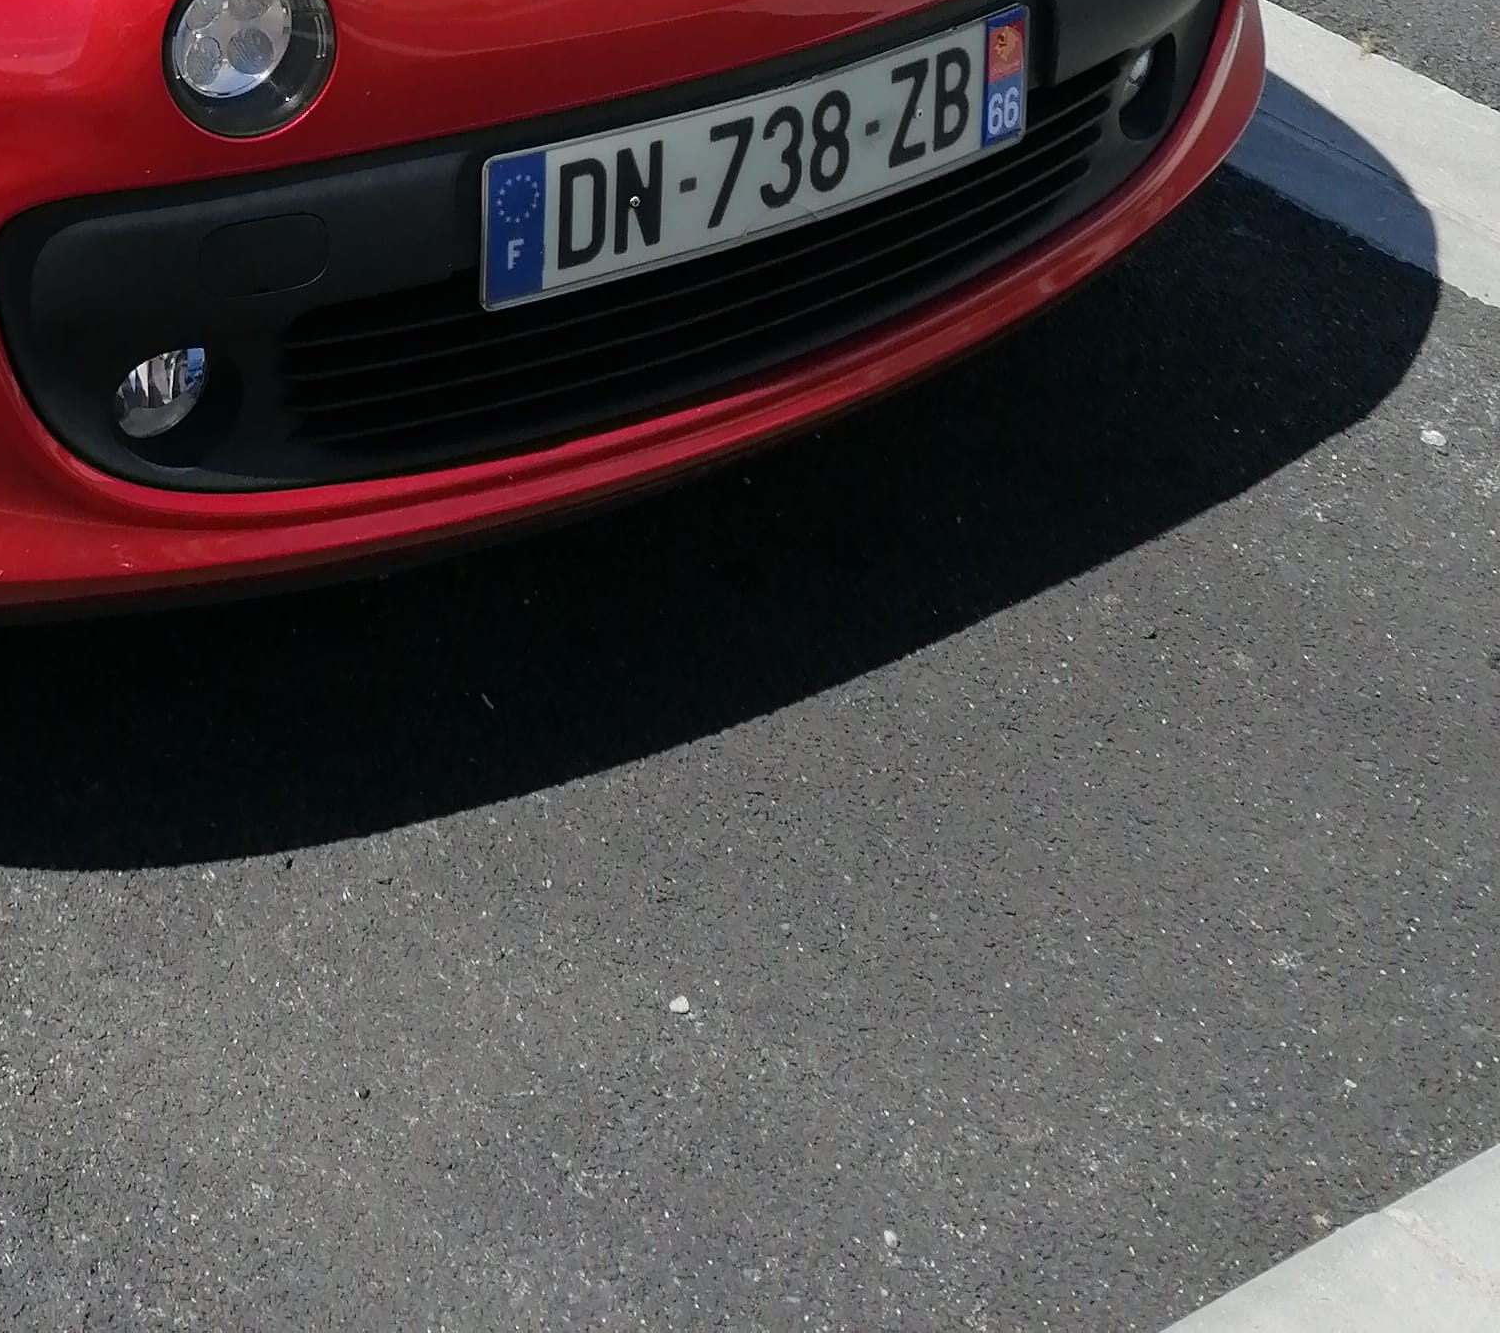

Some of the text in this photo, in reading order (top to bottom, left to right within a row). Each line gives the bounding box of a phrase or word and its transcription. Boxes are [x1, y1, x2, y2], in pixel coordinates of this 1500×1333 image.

[987, 86, 1020, 135] 66
[557, 46, 972, 271] DN-738-ZB
[507, 237, 525, 271] F
